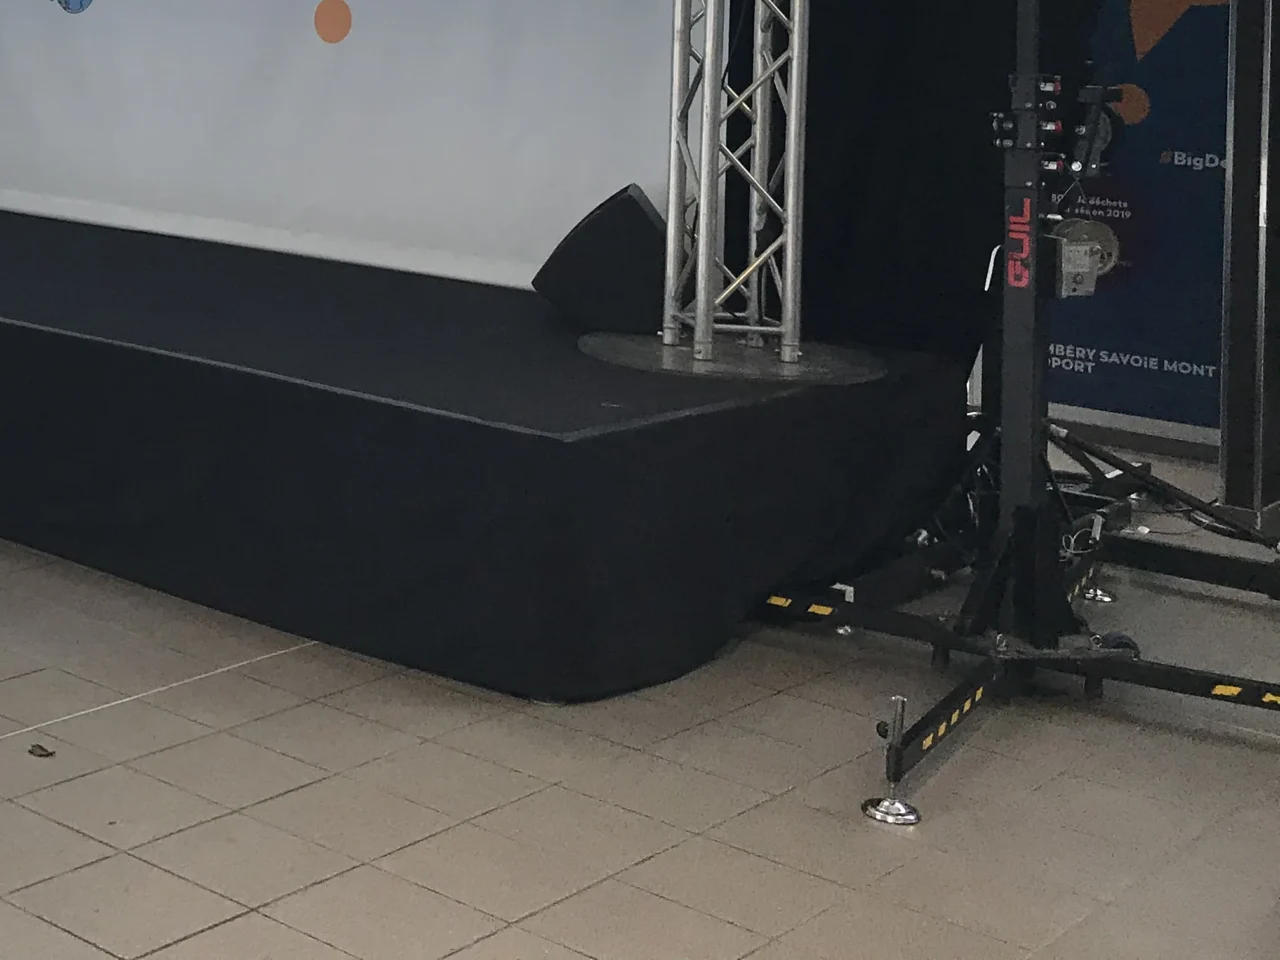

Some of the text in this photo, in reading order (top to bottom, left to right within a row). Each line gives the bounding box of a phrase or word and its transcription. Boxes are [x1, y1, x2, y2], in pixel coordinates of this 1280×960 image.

[1106, 209, 1132, 219] 2019
[1007, 197, 1031, 289] GUIL
[1163, 359, 1217, 378] MONT
